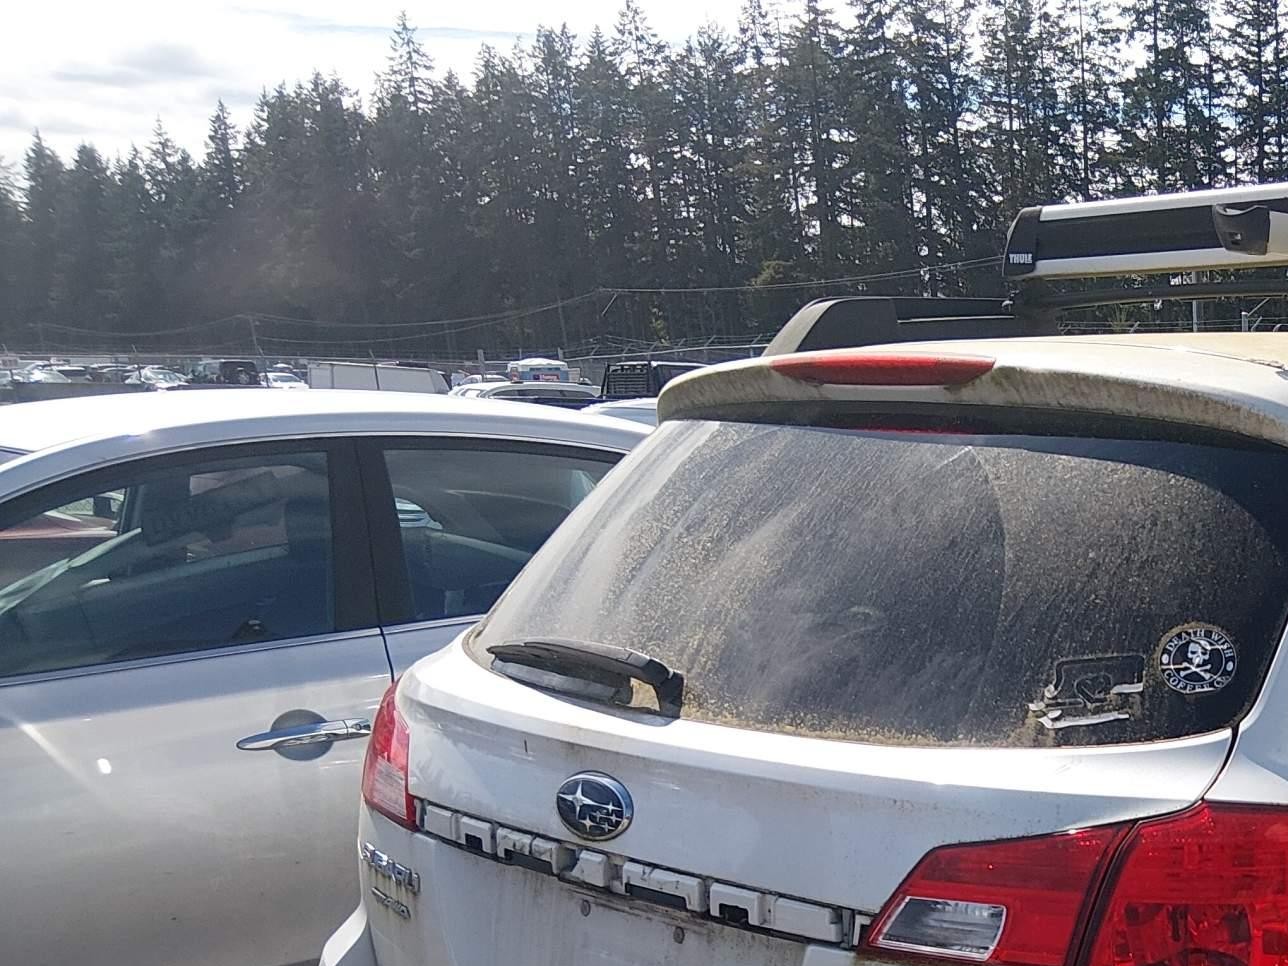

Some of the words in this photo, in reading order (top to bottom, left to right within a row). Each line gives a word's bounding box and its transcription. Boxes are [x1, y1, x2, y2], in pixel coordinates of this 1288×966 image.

[1009, 253, 1032, 264] THULE
[1166, 629, 1205, 652] DEATH
[1211, 630, 1234, 657] WISH
[1164, 670, 1211, 693] COFFEE
[363, 842, 421, 894] SUBARU
